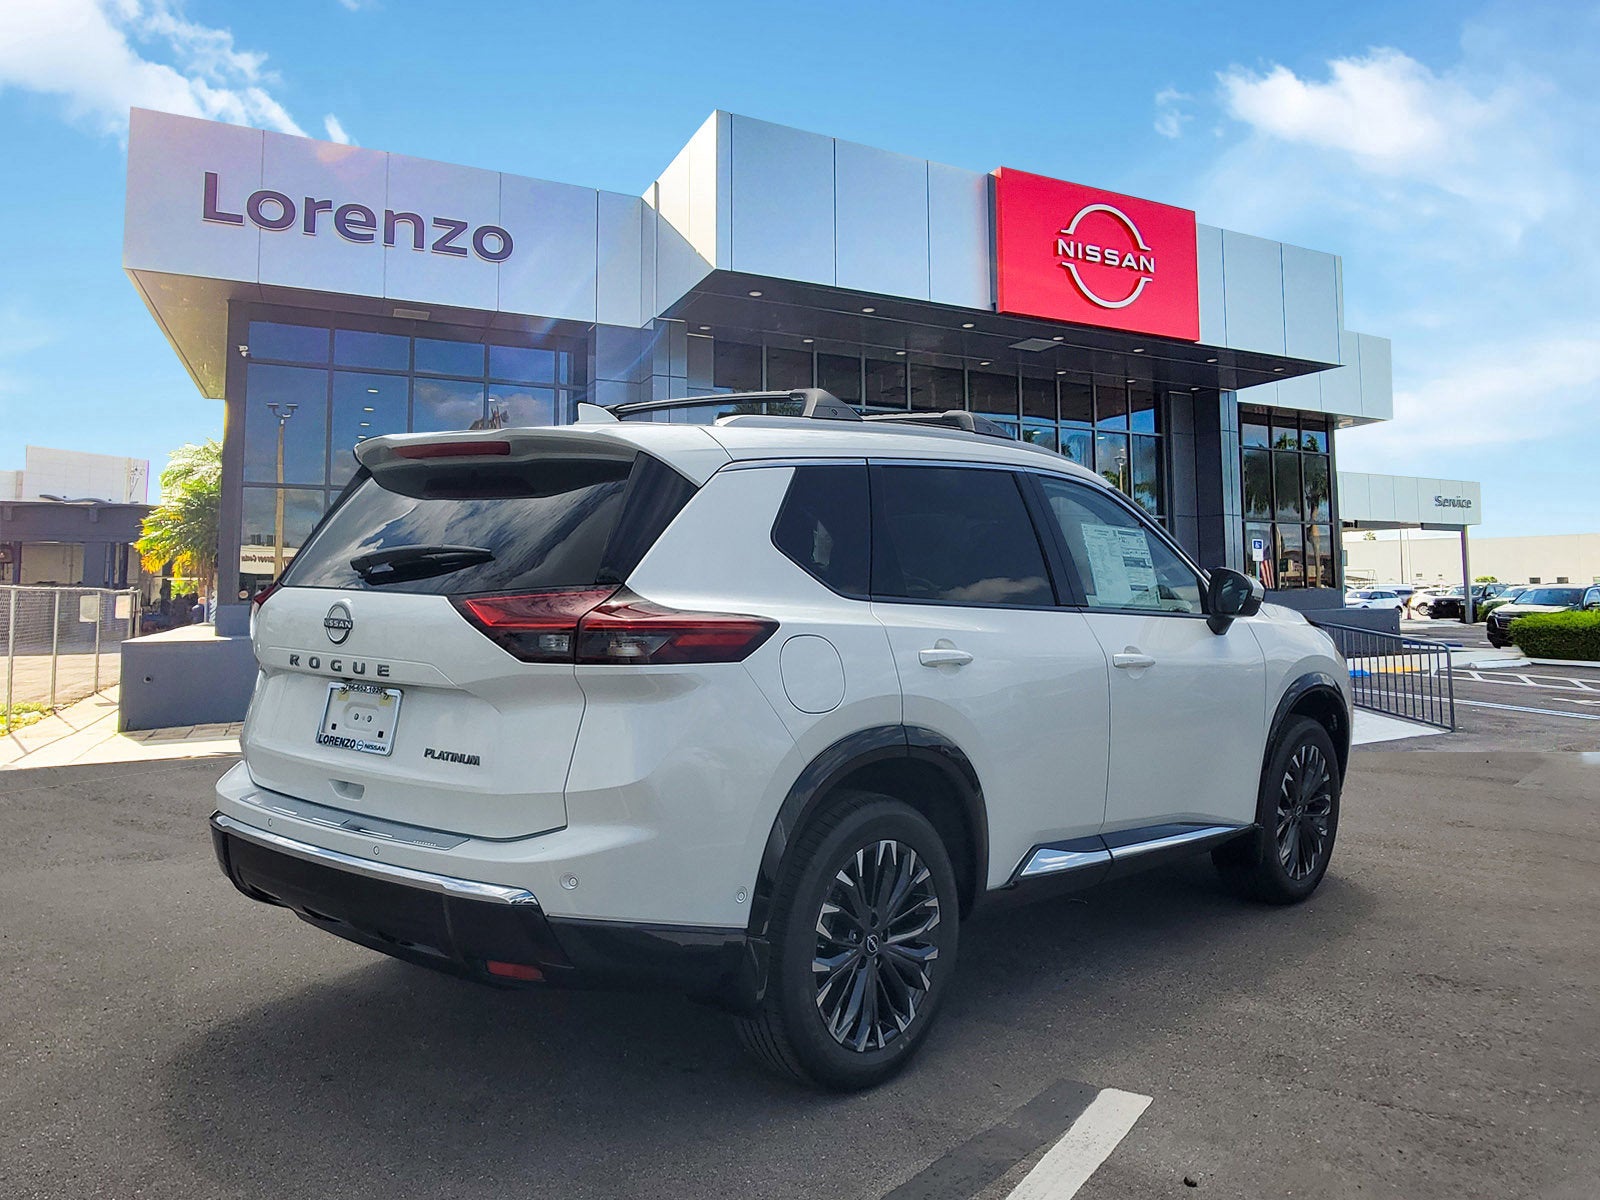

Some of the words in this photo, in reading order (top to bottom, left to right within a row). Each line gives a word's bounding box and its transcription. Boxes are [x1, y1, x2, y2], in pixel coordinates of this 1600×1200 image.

[202, 171, 514, 264] Lorenzo
[1057, 238, 1155, 273] NISSAN
[1434, 495, 1472, 509] Service
[324, 618, 353, 629] NISSAN
[289, 654, 390, 677] ROGUE
[318, 733, 356, 749] LORENZO
[364, 743, 386, 752] NISSAN
[424, 748, 480, 766] PLATINUM
